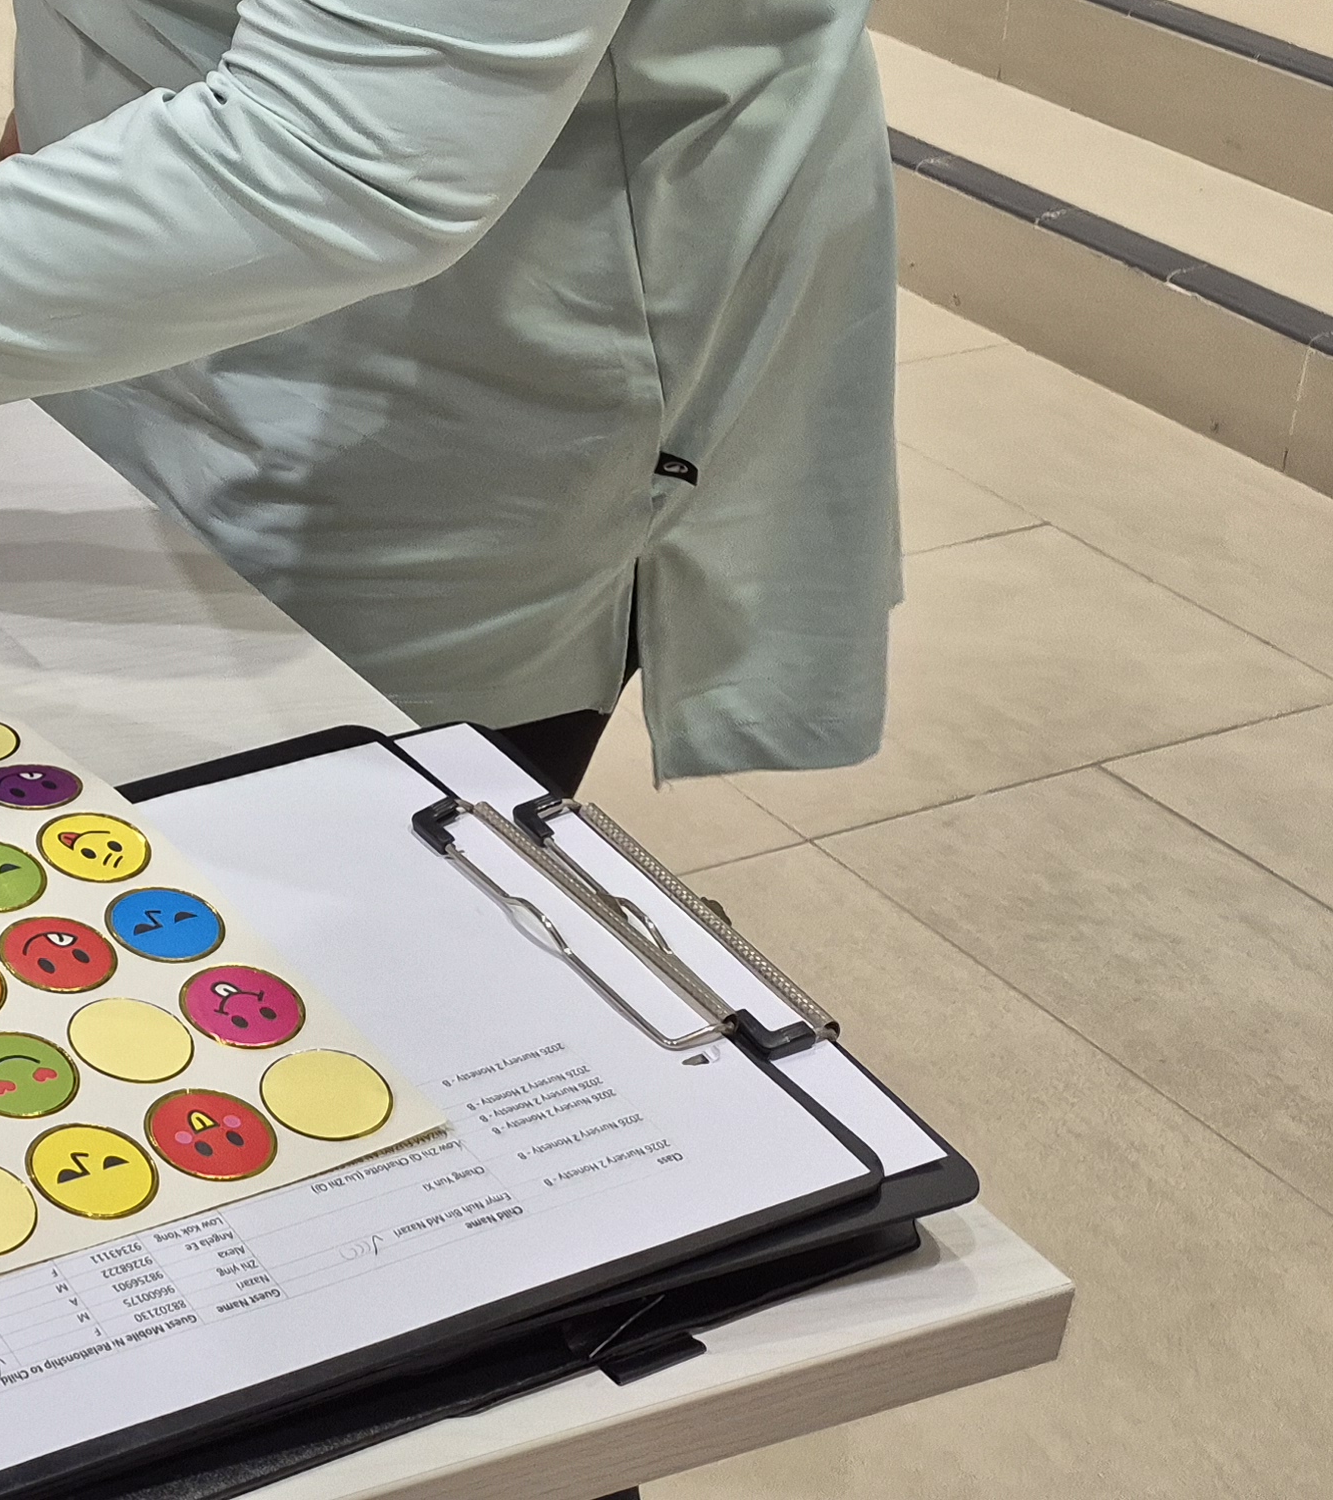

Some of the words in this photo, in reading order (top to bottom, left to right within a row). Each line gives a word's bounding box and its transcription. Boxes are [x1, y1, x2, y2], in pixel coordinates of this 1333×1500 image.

[538, 1041, 564, 1056] 2026
[494, 1061, 503, 1070] 2
[501, 1048, 540, 1068] Nursery
[454, 1062, 495, 1083] Honesty
[564, 1063, 590, 1079] 2026
[519, 1084, 528, 1094] 2
[526, 1071, 565, 1091] Nursery
[577, 1075, 602, 1091] 2026
[479, 1085, 520, 1106] Honesty
[531, 1096, 541, 1106] 2
[539, 1082, 578, 1103] Nursery
[590, 1088, 615, 1103] 2026
[491, 1097, 533, 1118] Honesty
[545, 1108, 554, 1117] 2
[552, 1094, 591, 1115] Nursery
[505, 1109, 546, 1130] Honesty
[617, 1112, 642, 1127] 2026
[571, 1132, 580, 1142] 2
[579, 1119, 618, 1140] Nursery
[531, 1134, 572, 1155] Honesty
[644, 1138, 670, 1154] 2026
[598, 1158, 607, 1169] 2
[606, 1146, 645, 1167] Nursery
[656, 1150, 683, 1167] Class
[363, 1155, 408, 1178] Charlotte
[451, 1162, 484, 1182] Chang
[557, 1161, 599, 1182] Honesty
[422, 1181, 434, 1192] Xi
[433, 1174, 454, 1188] Yun
[445, 1207, 462, 1220] Bin
[461, 1200, 484, 1215] Nuh
[495, 1204, 523, 1221] Child
[200, 1215, 222, 1230] Low
[392, 1219, 425, 1238] Nazari
[425, 1213, 445, 1227] Md
[464, 1213, 496, 1231] Name
[152, 1225, 181, 1246] Yong
[180, 1222, 201, 1237] Kok
[198, 1227, 234, 1249] Angela
[184, 1240, 199, 1253] Ee
[217, 1243, 245, 1261] Alexa
[215, 1260, 241, 1280] ying
[240, 1258, 258, 1272] Zhi
[55, 1282, 68, 1293] M
[235, 1272, 269, 1291] Nazari
[68, 1296, 78, 1307] A
[248, 1286, 280, 1305] Guest
[215, 1297, 249, 1315] Name
[76, 1311, 89, 1323] M
[164, 1312, 197, 1331] Guest
[125, 1323, 165, 1344] Mobile
[41, 1339, 111, 1372] Relationship
[0, 1368, 30, 1386] Child
[28, 1363, 43, 1375] to
